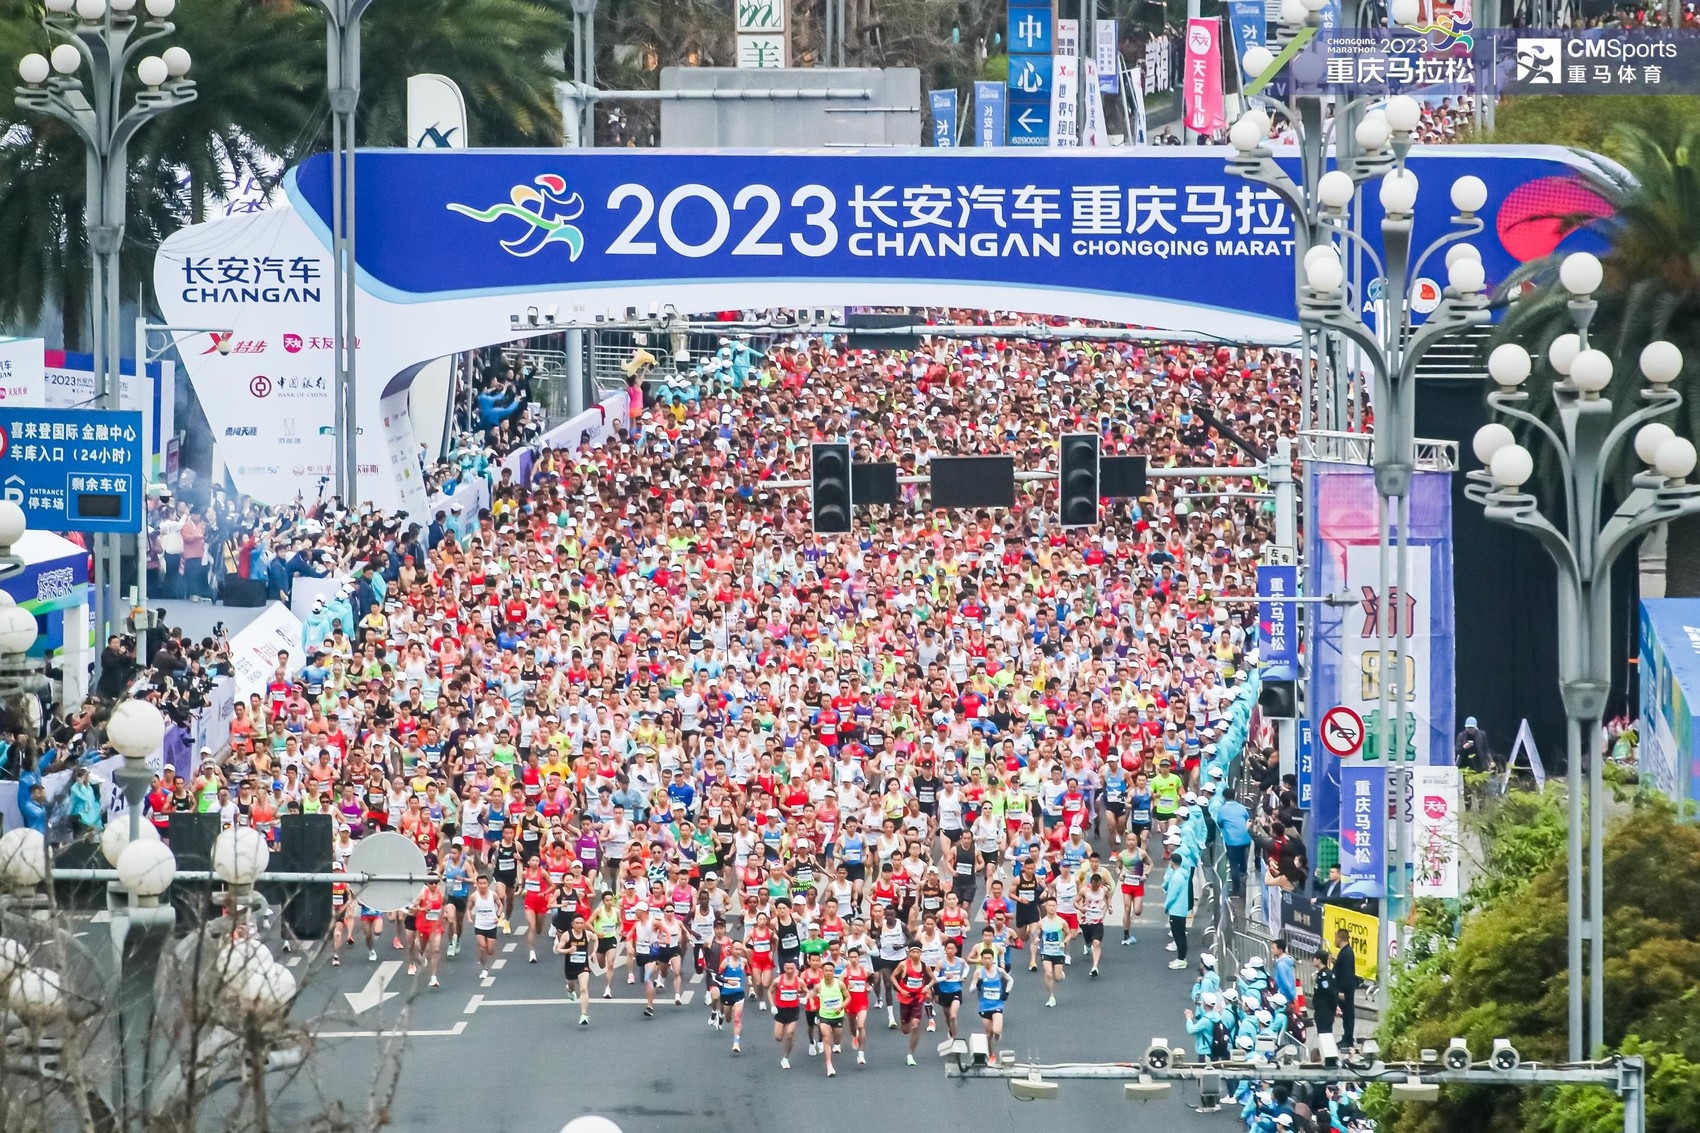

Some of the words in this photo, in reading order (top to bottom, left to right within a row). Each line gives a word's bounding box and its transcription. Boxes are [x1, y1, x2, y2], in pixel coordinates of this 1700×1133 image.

[848, 184, 1061, 228] 长安汽车
[1071, 185, 1310, 234] 重庆马拉
[605, 183, 839, 258] 2023
[848, 232, 1060, 257] CHANGAN
[1073, 240, 1209, 259] CHONGQING
[182, 257, 320, 284] 长安汽车
[182, 288, 320, 302] CHANGAN
[52, 374, 76, 387] 2023
[30, 488, 64, 496] ENTRANCE
[71, 477, 127, 492] 剩余车位
[28, 497, 64, 510] 停车场
[1270, 577, 1285, 651] 重庆马拉松
[1354, 780, 1371, 864] 重庆马拉松
